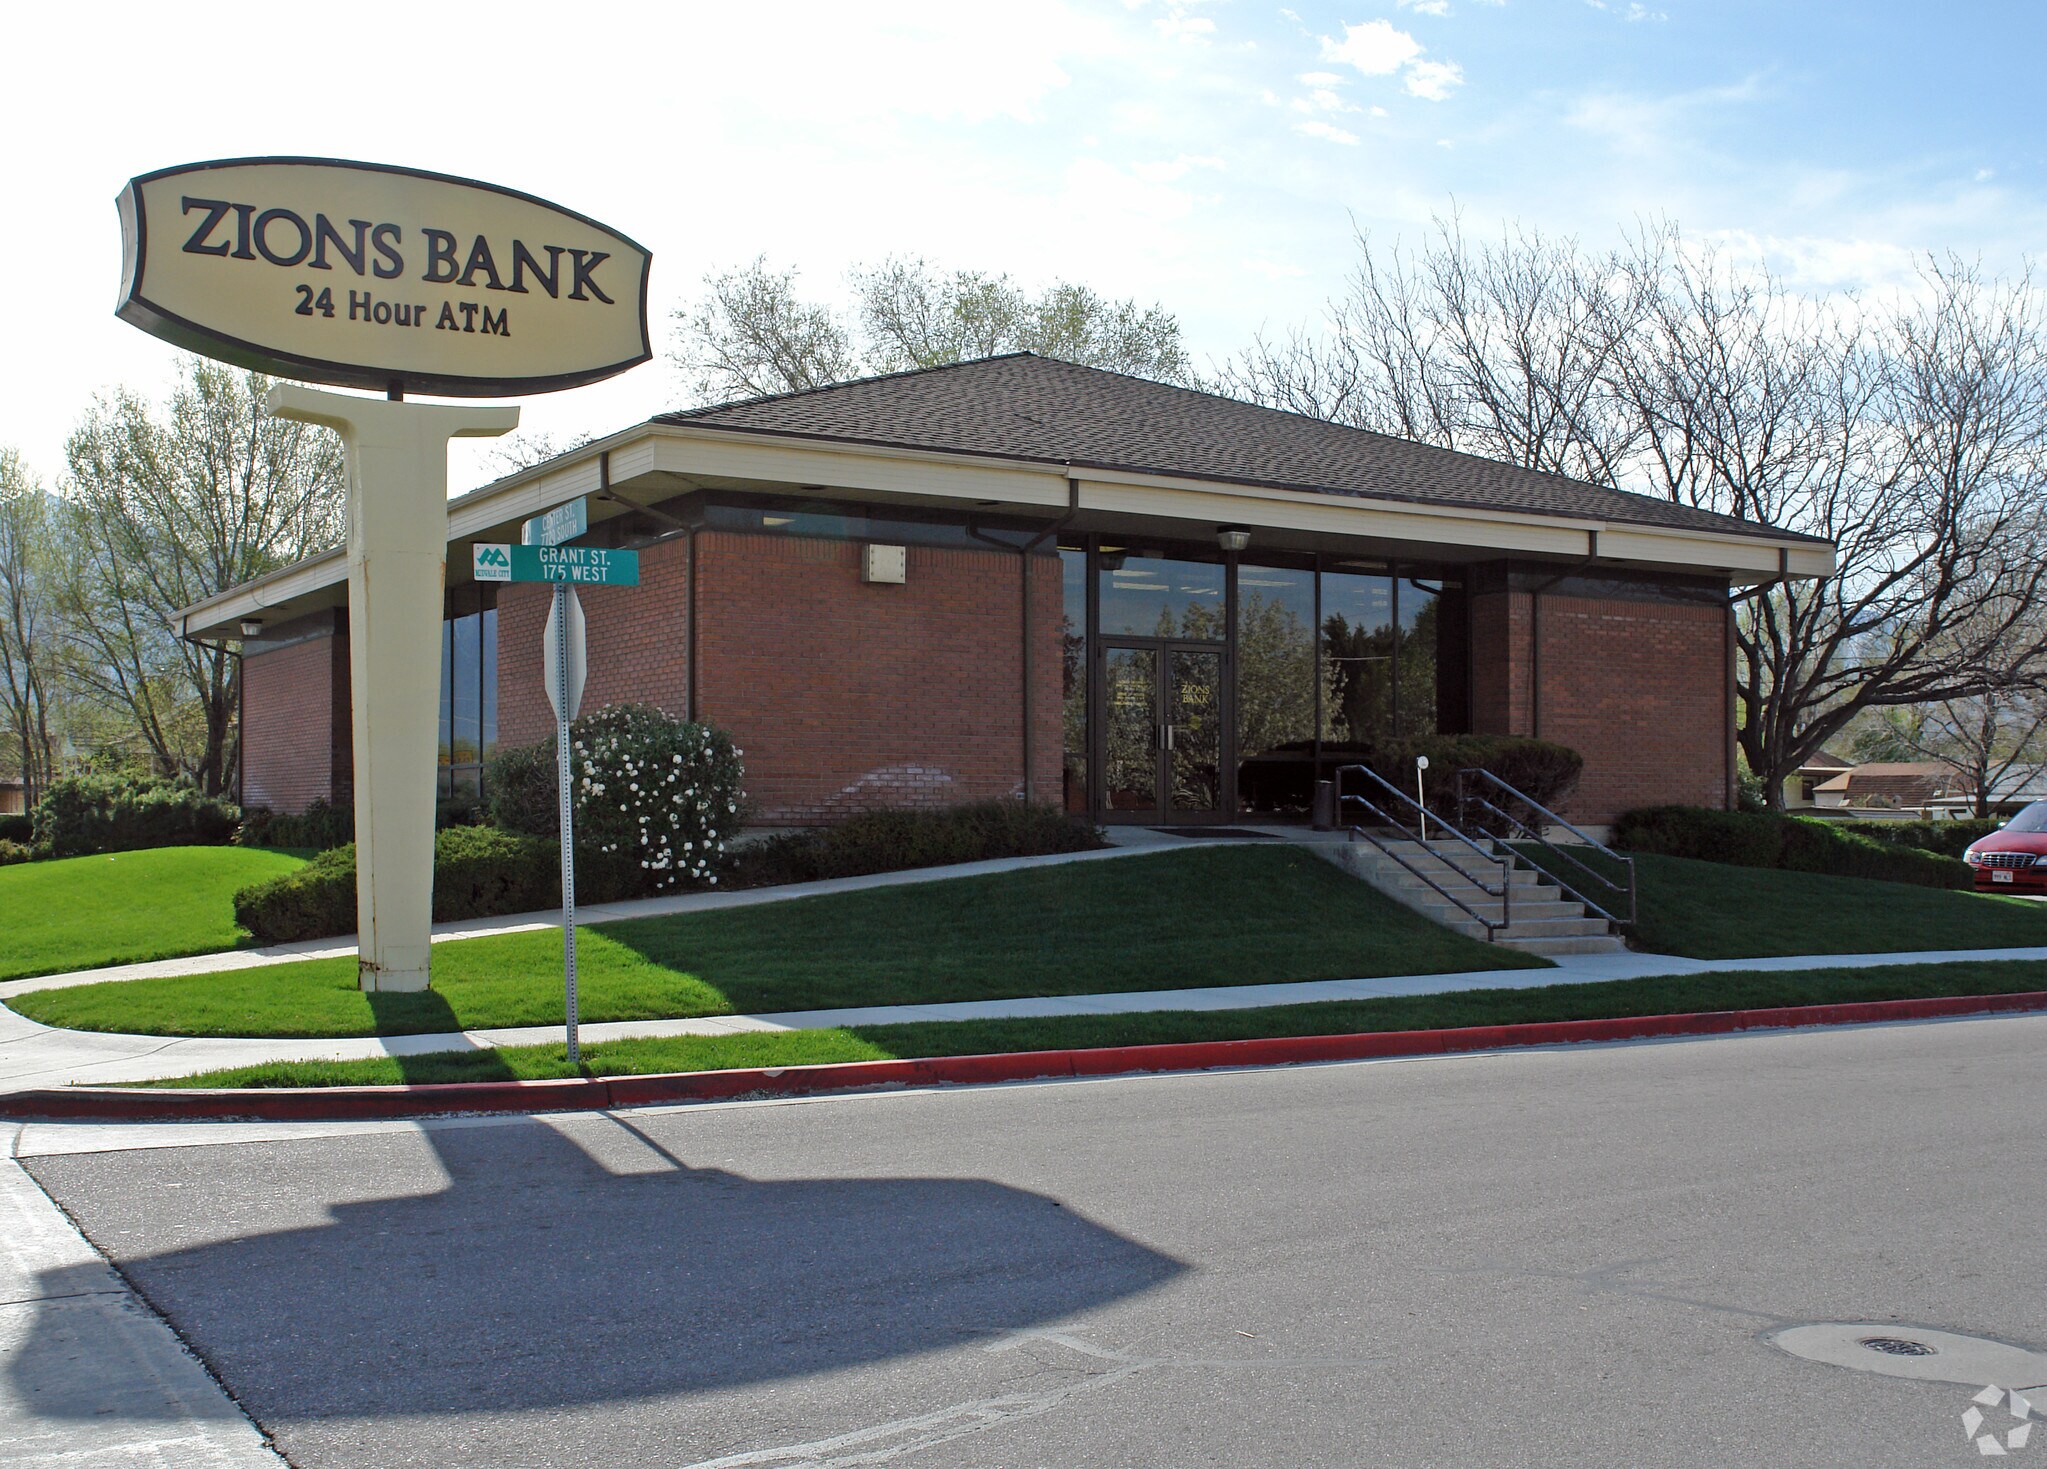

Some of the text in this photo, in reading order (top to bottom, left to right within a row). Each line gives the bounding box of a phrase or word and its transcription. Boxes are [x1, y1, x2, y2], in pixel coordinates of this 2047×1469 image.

[181, 195, 616, 305] ZIONS BANK
[294, 283, 511, 338] 24 Hour ATM
[564, 503, 575, 521] ST.
[557, 519, 577, 541] SOUTH
[539, 547, 611, 566] GRANT ST.
[542, 564, 608, 582] 175 WEST
[1181, 684, 1210, 695] ZIONS
[1182, 694, 1209, 704] BANK
